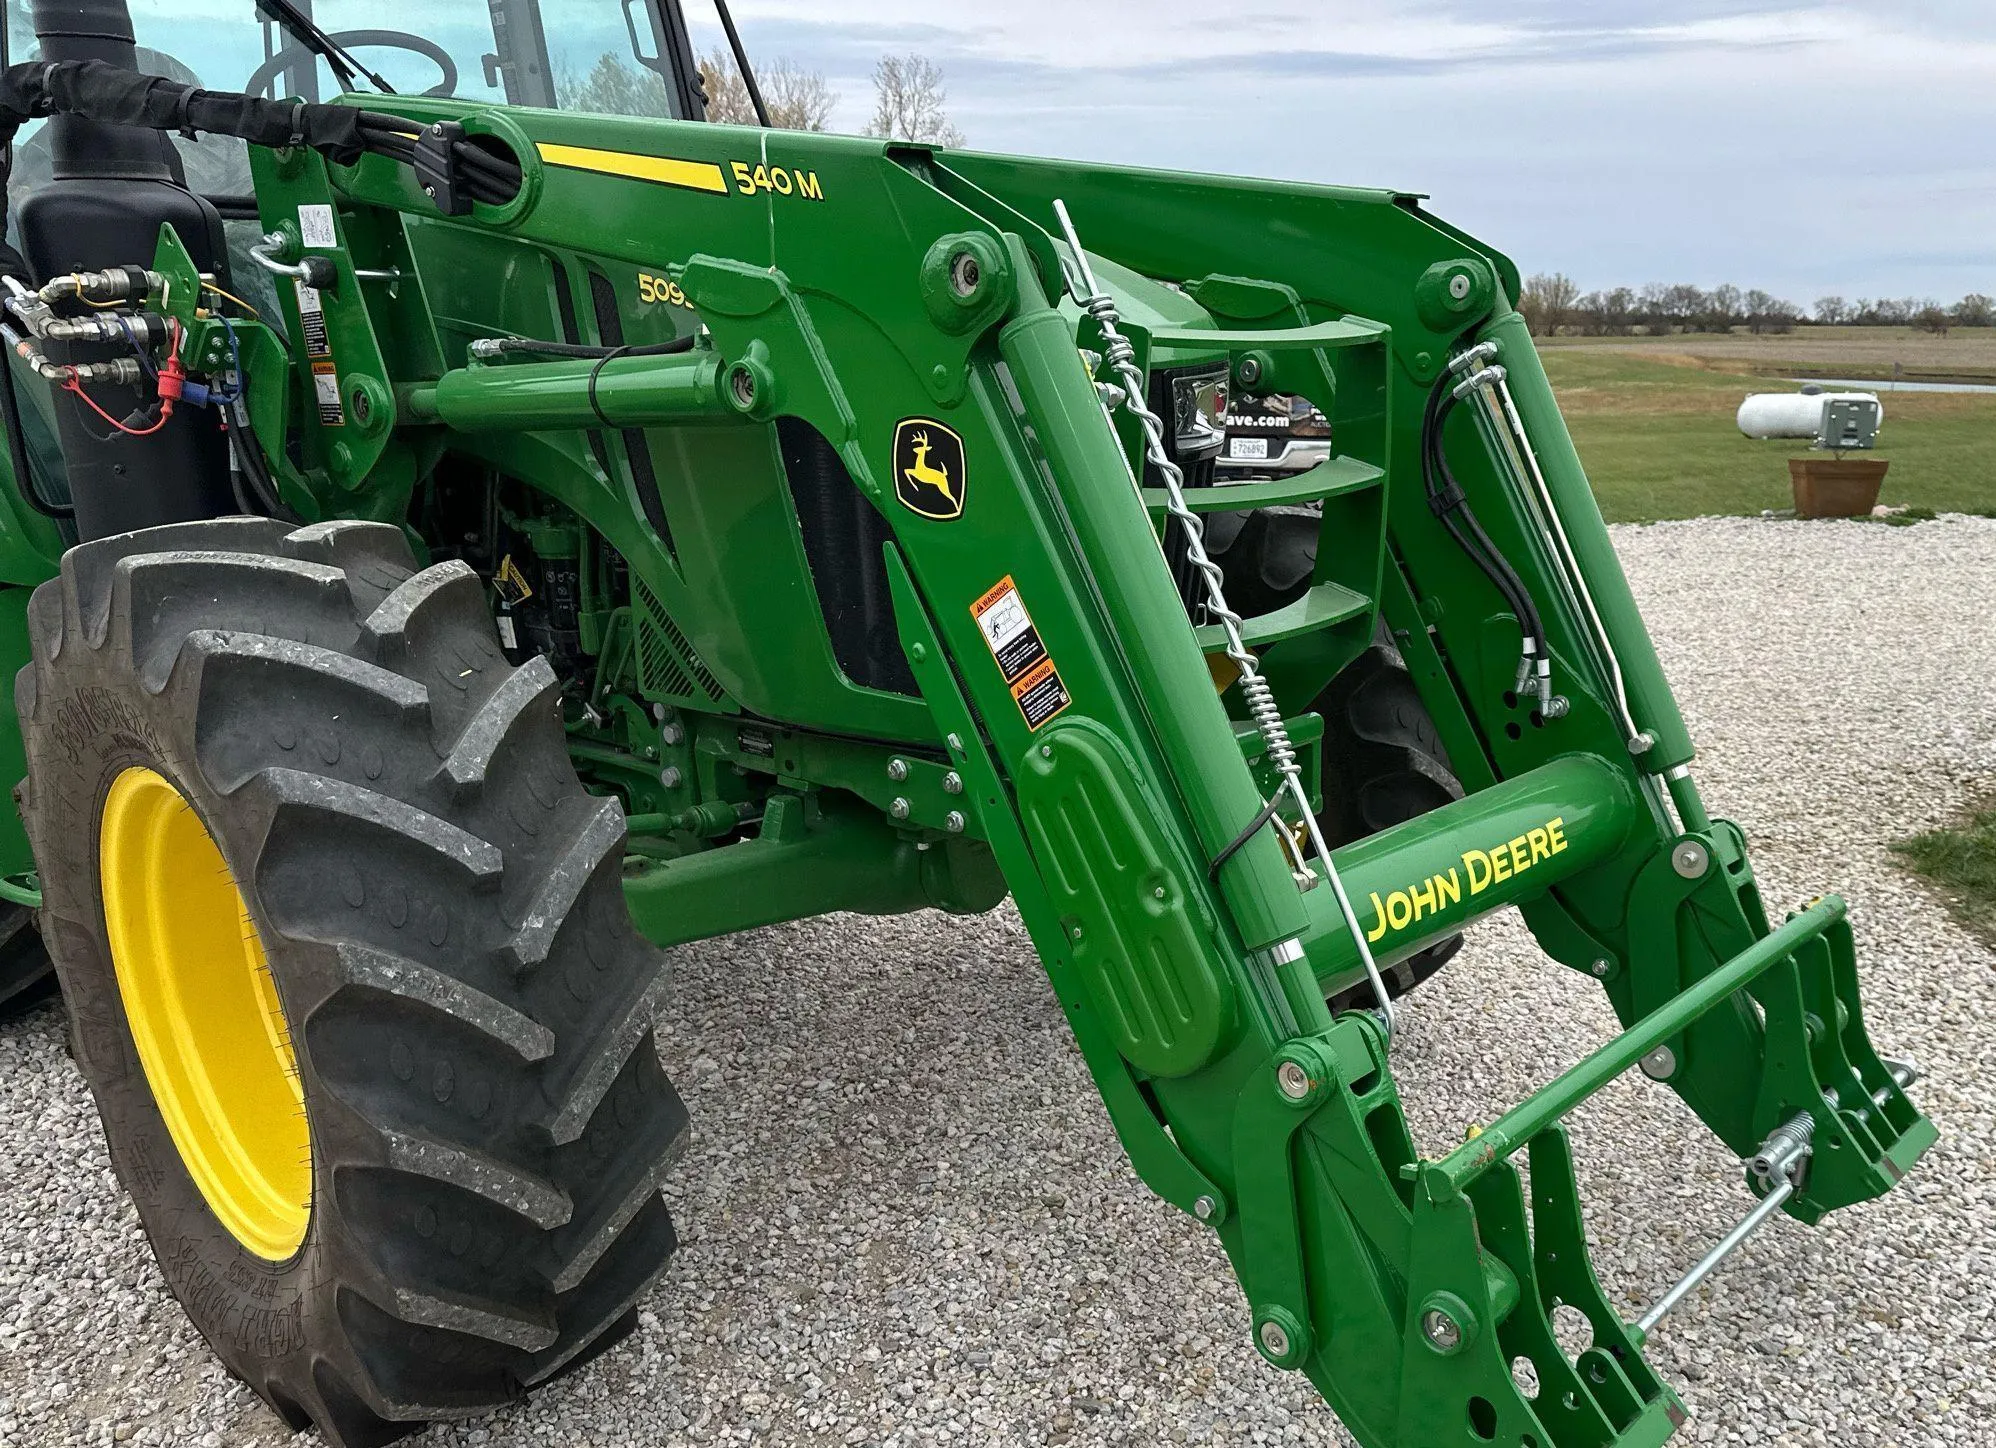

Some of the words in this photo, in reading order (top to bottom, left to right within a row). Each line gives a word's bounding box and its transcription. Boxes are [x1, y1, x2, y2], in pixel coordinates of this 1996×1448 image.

[729, 160, 793, 196] 540
[793, 168, 826, 202] M
[637, 272, 695, 310] 509
[981, 582, 1010, 608] WARNING
[1022, 665, 1051, 690] WARNING
[1367, 866, 1462, 943] JOHN
[1460, 816, 1569, 896] DEERE
